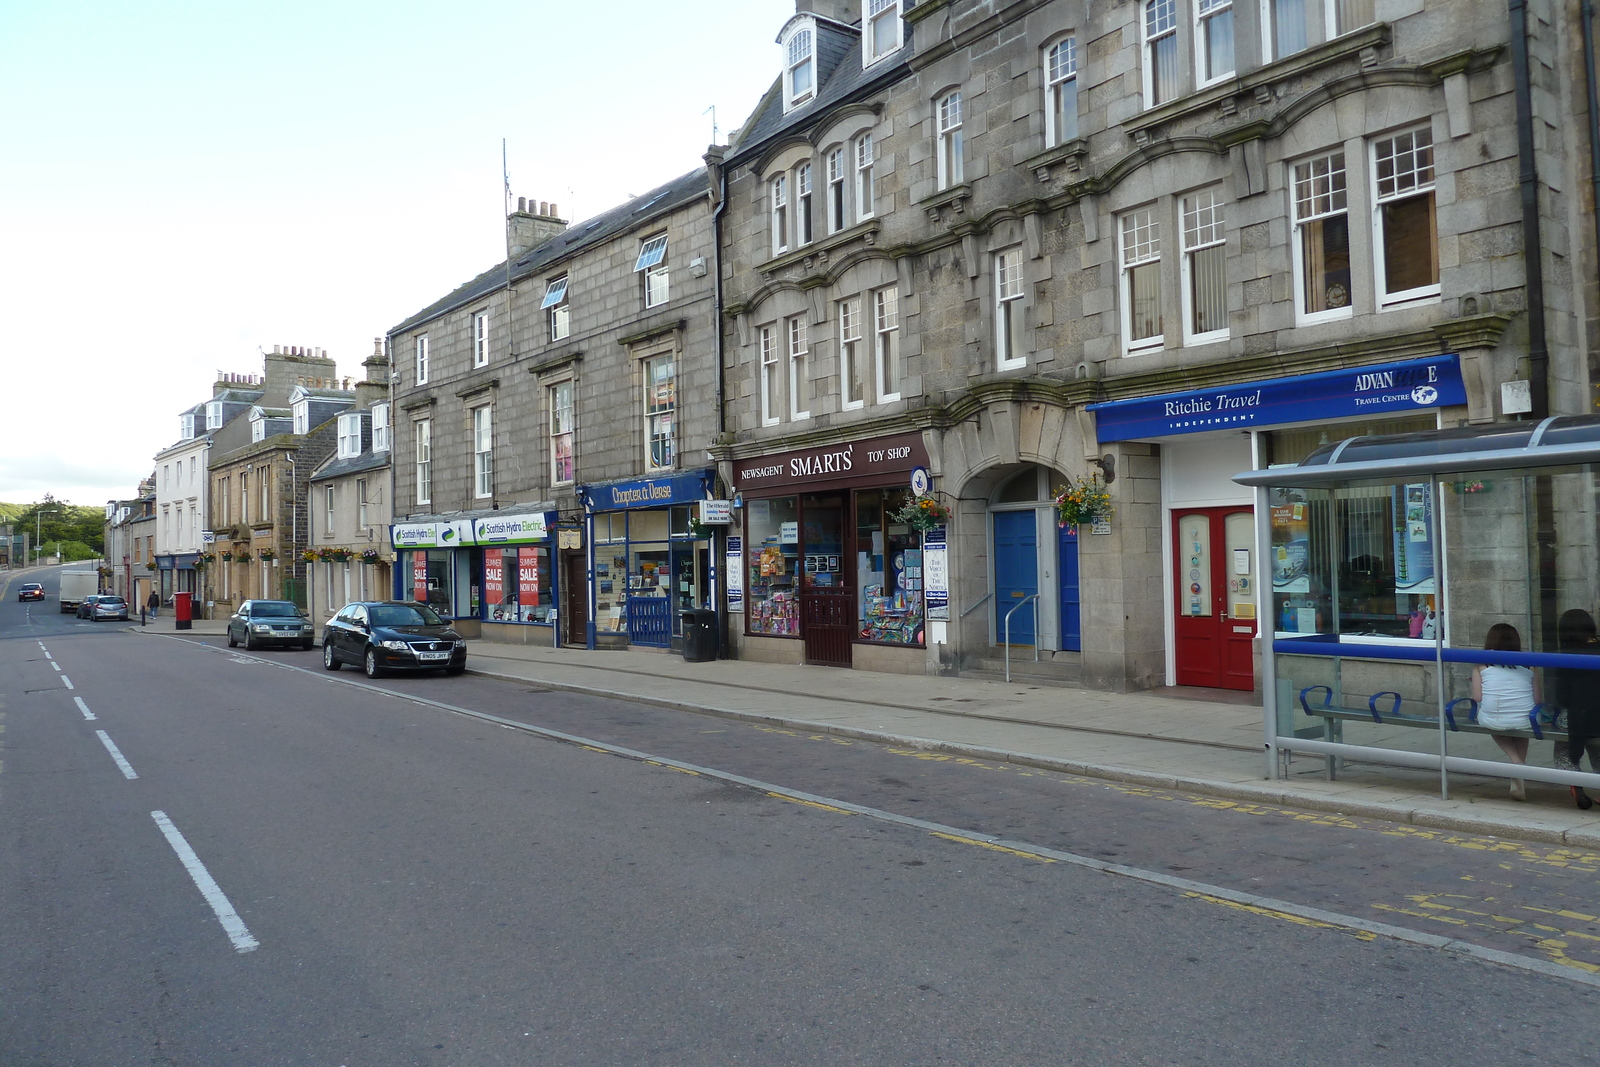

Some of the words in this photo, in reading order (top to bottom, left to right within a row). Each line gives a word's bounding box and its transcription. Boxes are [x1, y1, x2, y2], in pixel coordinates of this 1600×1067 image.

[1164, 397, 1212, 416] Ritchie
[1215, 389, 1261, 410] Travel
[1169, 414, 1255, 428] INDEPENDENT
[741, 464, 784, 479] NEWSAGENT
[790, 444, 854, 477] SMARTS'
[867, 450, 885, 463] TOY
[887, 446, 911, 460] SHOP
[486, 522, 506, 534] Scottish
[506, 521, 522, 535] Hydro
[522, 519, 542, 532] Electric
[402, 529, 415, 539] Scottish
[415, 528, 428, 541] Hydro
[486, 558, 502, 567] SUMMER
[520, 558, 537, 567] SUMMER
[414, 568, 427, 580] SALE
[486, 568, 502, 581] SALE
[520, 568, 537, 581] SALE
[486, 582, 495, 591] NOW
[496, 582, 502, 591] ON
[520, 583, 531, 592] NOW
[531, 583, 538, 592] ON
